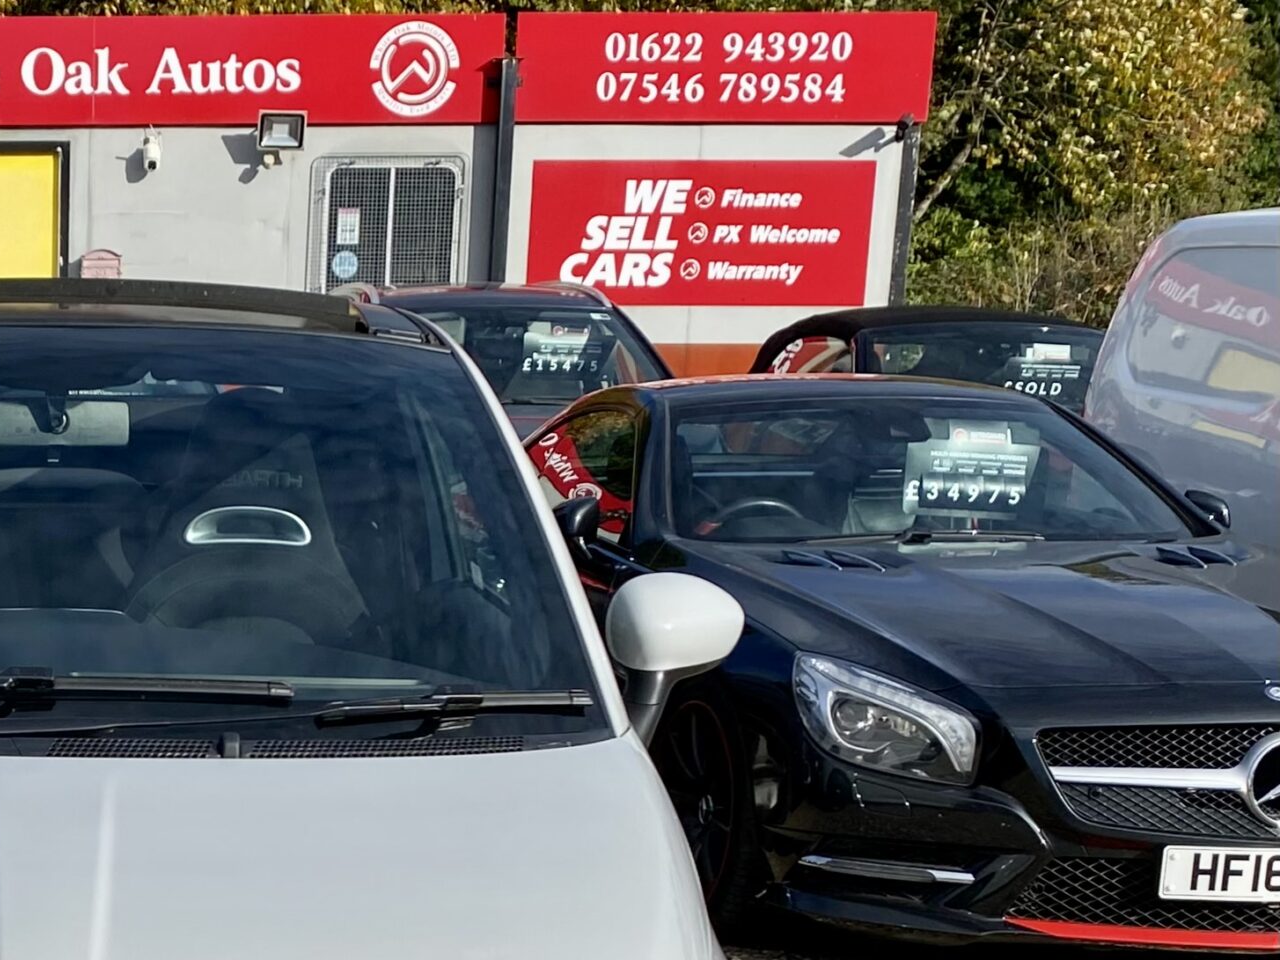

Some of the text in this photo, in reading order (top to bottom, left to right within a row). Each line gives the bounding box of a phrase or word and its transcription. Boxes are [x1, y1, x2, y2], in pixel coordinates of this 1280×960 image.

[604, 31, 853, 63] 01622 943920
[20, 47, 130, 96] Oak
[145, 47, 302, 95] Autos
[596, 72, 846, 104] 07546 789584
[623, 180, 693, 215] WE
[720, 189, 803, 208] Finance
[580, 215, 679, 252] SELL
[712, 224, 841, 244] PX Welcome
[558, 251, 675, 288] CARS
[707, 261, 804, 286] Warranty
[522, 357, 598, 372] £15475
[216, 469, 304, 489] ARTH
[905, 480, 1021, 505] £34975
